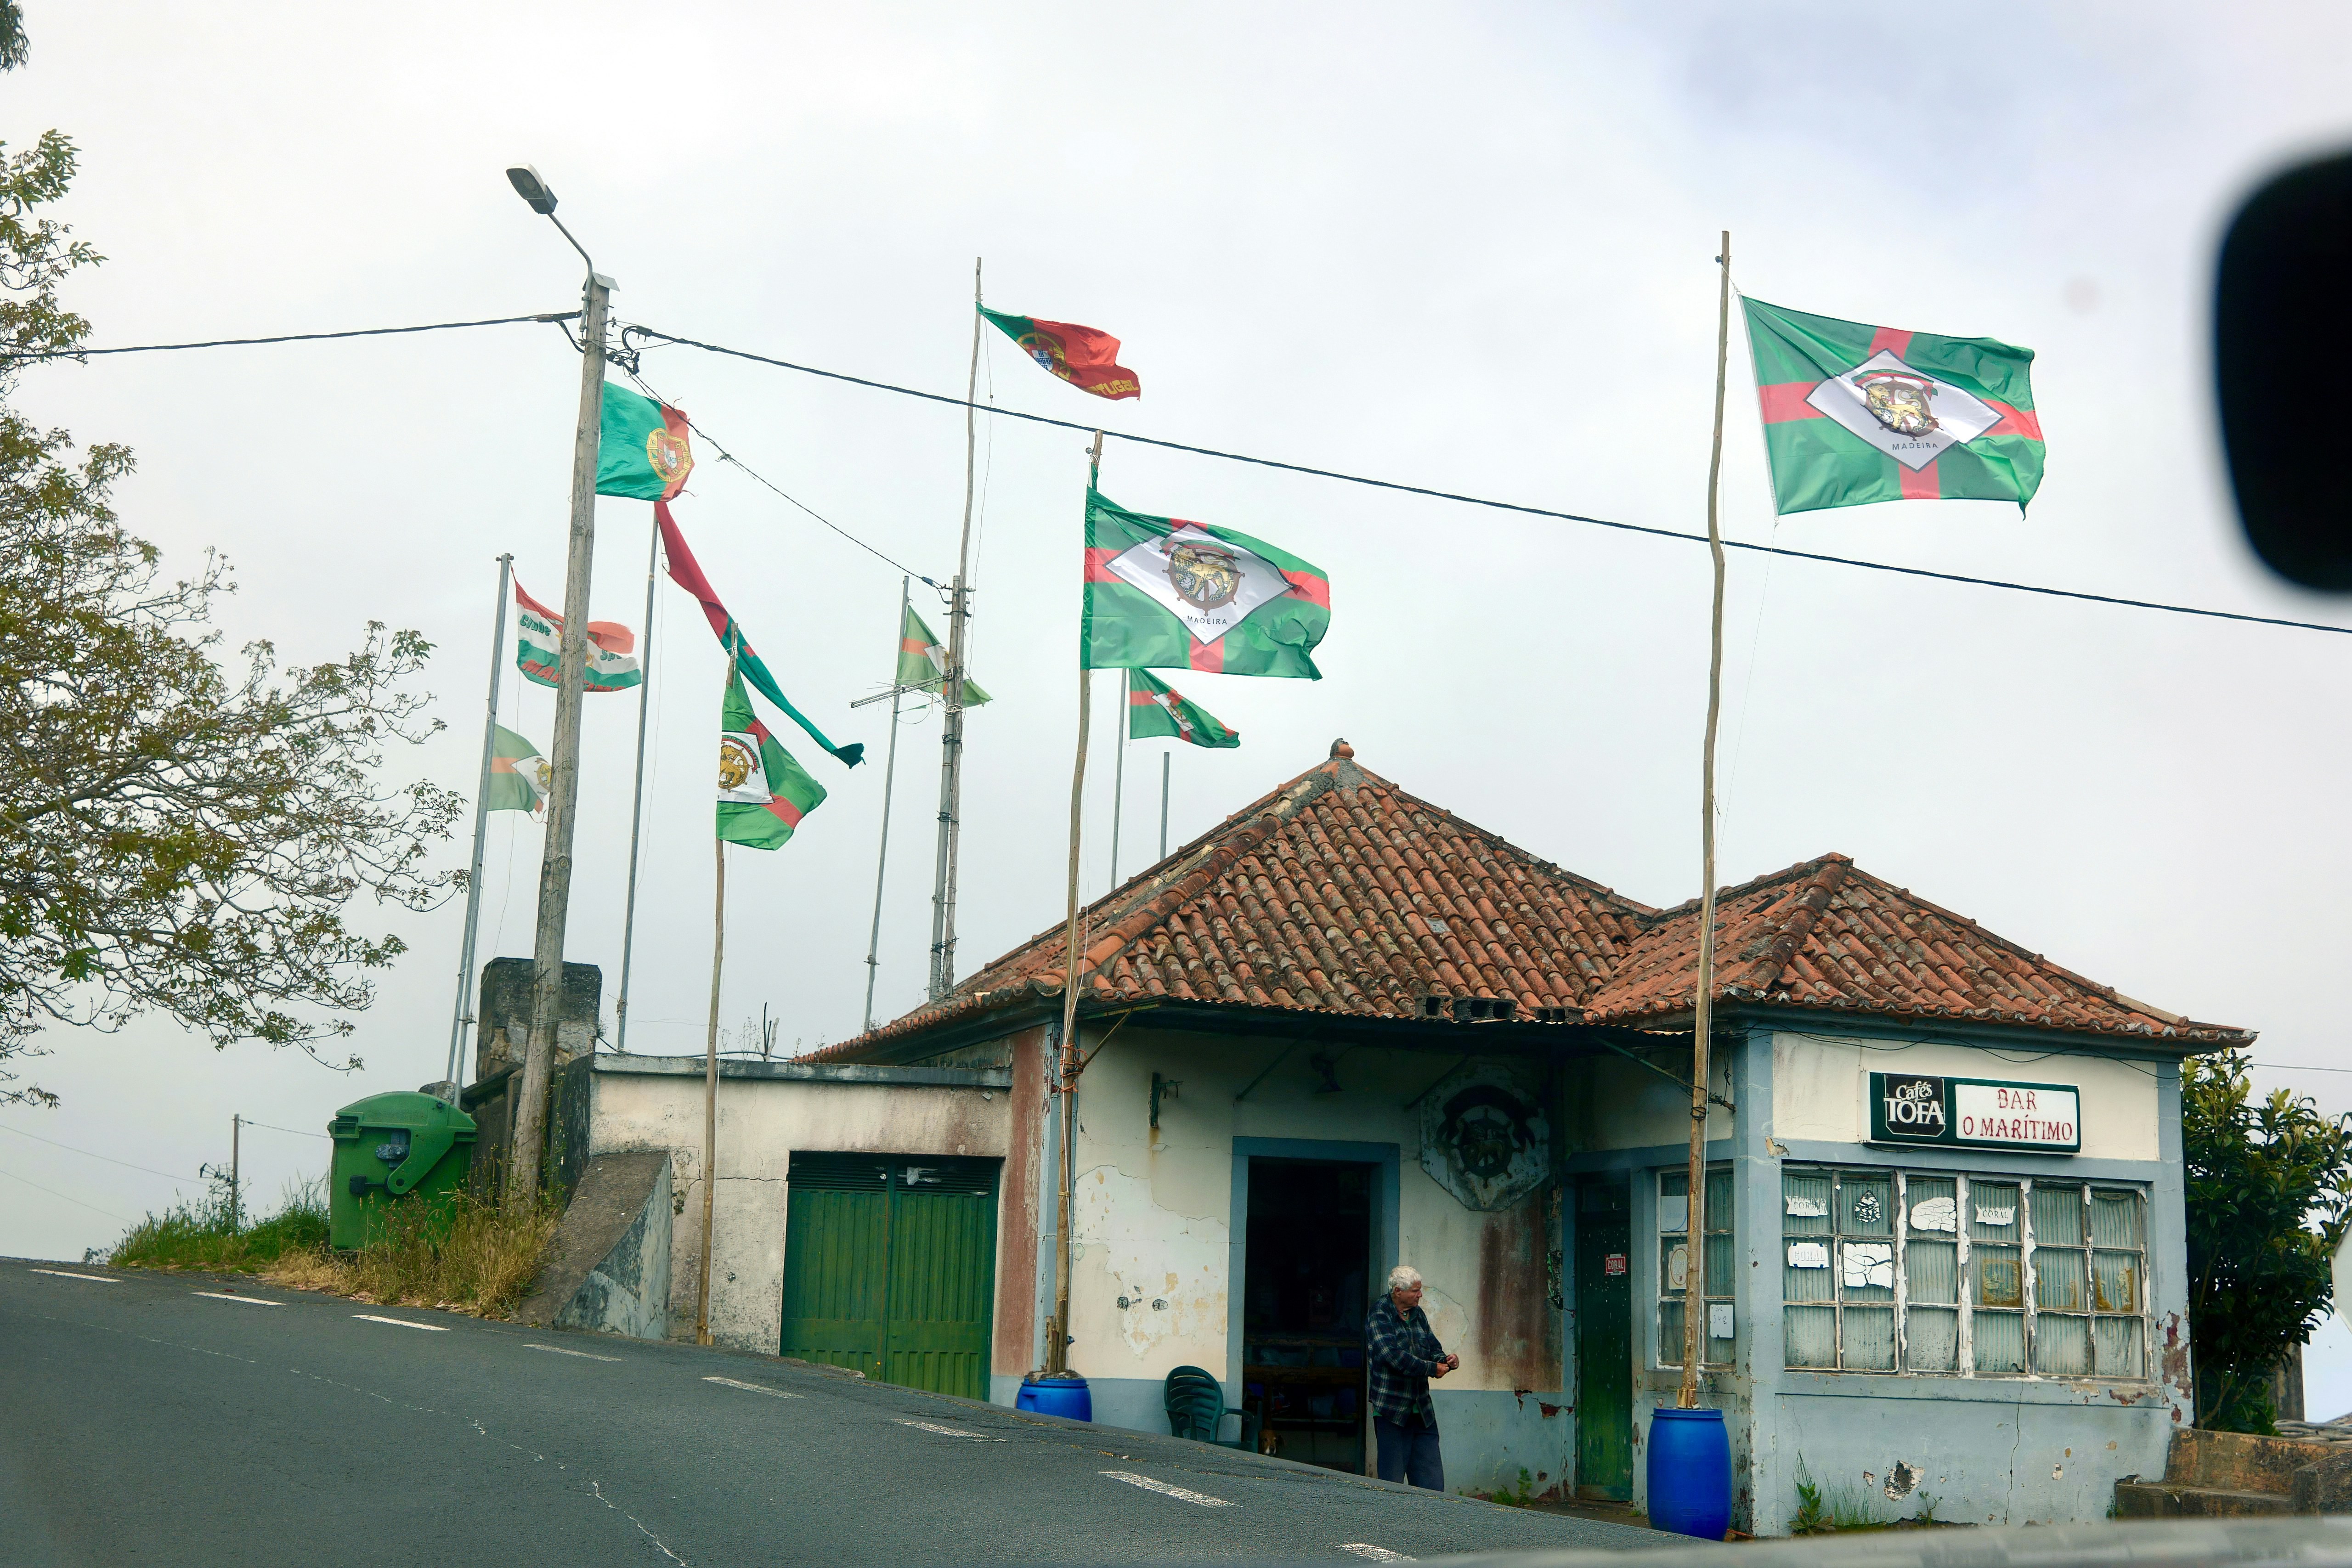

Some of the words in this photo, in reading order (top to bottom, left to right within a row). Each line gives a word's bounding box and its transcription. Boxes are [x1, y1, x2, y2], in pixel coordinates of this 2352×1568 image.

[1892, 442, 1938, 451] MADEIRA
[519, 614, 551, 636] Clube
[1187, 615, 1227, 625] MADEIRA
[1895, 1081, 1933, 1104] Cafés
[1998, 1089, 2037, 1110] BAR
[1883, 1098, 1946, 1125] TOFA
[1963, 1116, 1974, 1135] O
[1979, 1114, 2073, 1140] MARÍTIMO
[1608, 1259, 1623, 1270] CORAL
